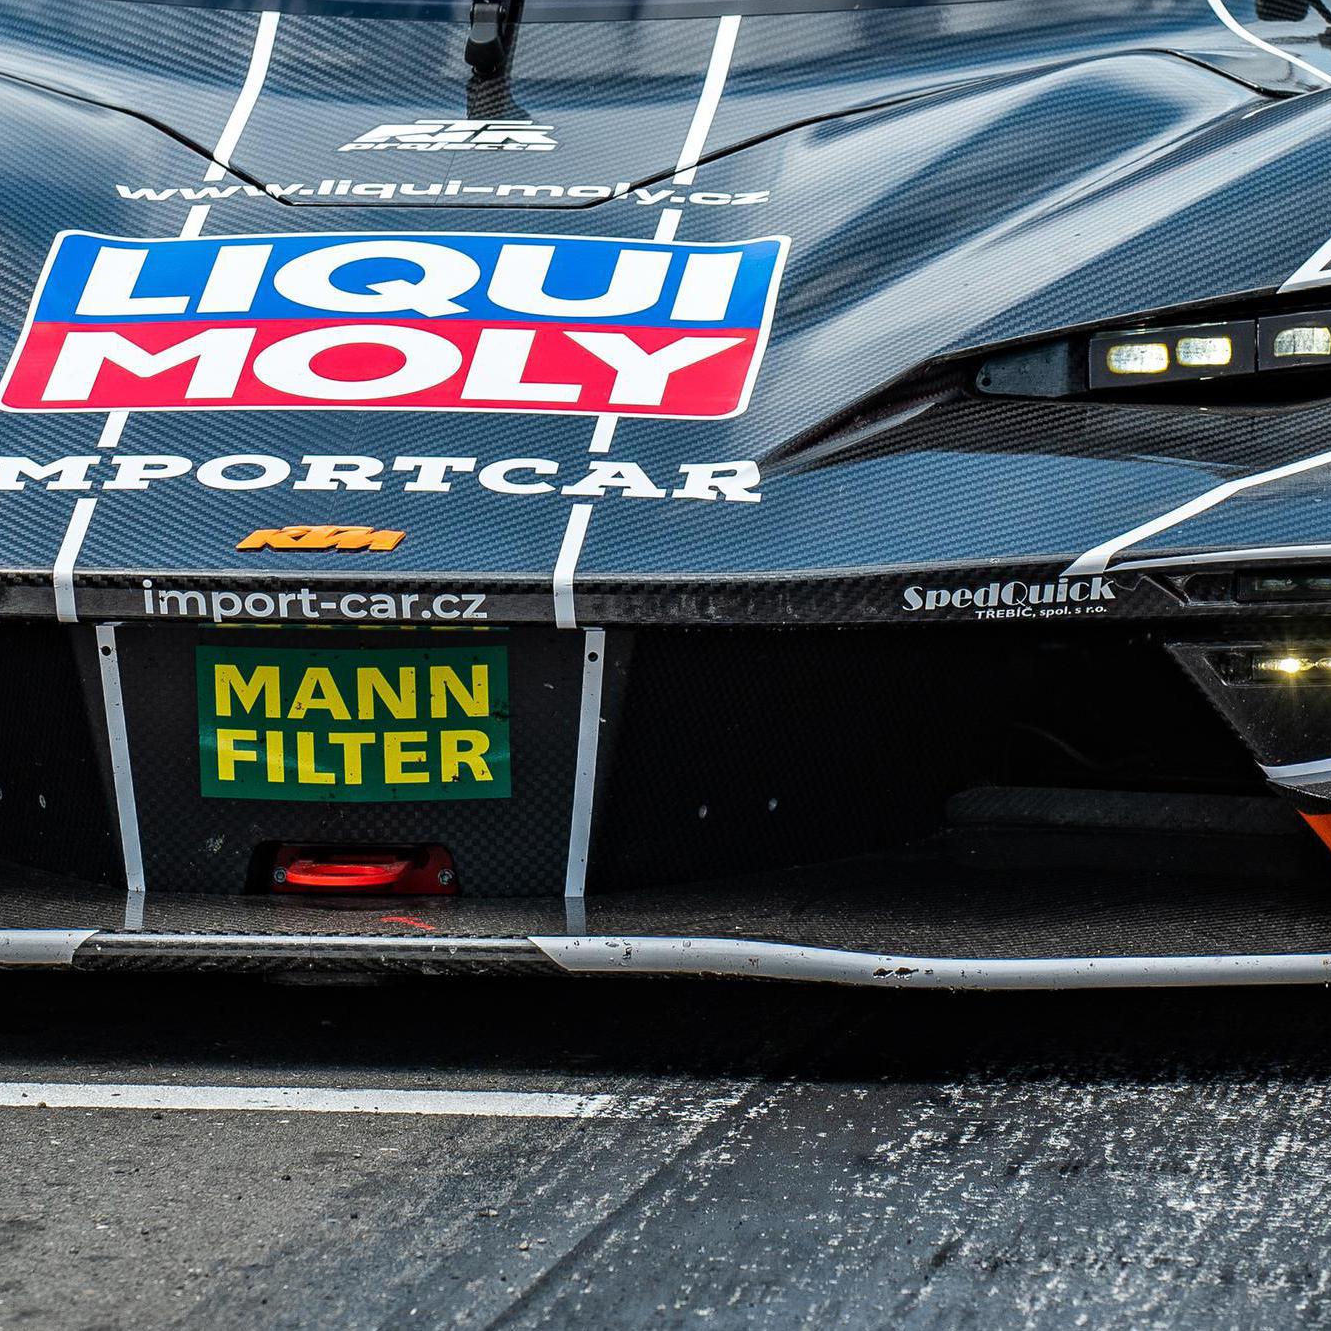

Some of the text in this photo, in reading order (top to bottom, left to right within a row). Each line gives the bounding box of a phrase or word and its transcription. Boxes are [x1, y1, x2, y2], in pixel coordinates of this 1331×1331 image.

[115, 179, 770, 206] www.liqui-moly.cz
[75, 236, 744, 319] LIQUI
[40, 323, 748, 406] MOLY
[236, 525, 406, 552] KTM
[142, 579, 488, 622] import-car.cz
[902, 576, 1116, 611] SpedQuick
[1039, 605, 1071, 618] spol.
[1086, 604, 1107, 614] r.o.
[214, 664, 490, 720] MANN
[216, 728, 494, 785] FILTER
